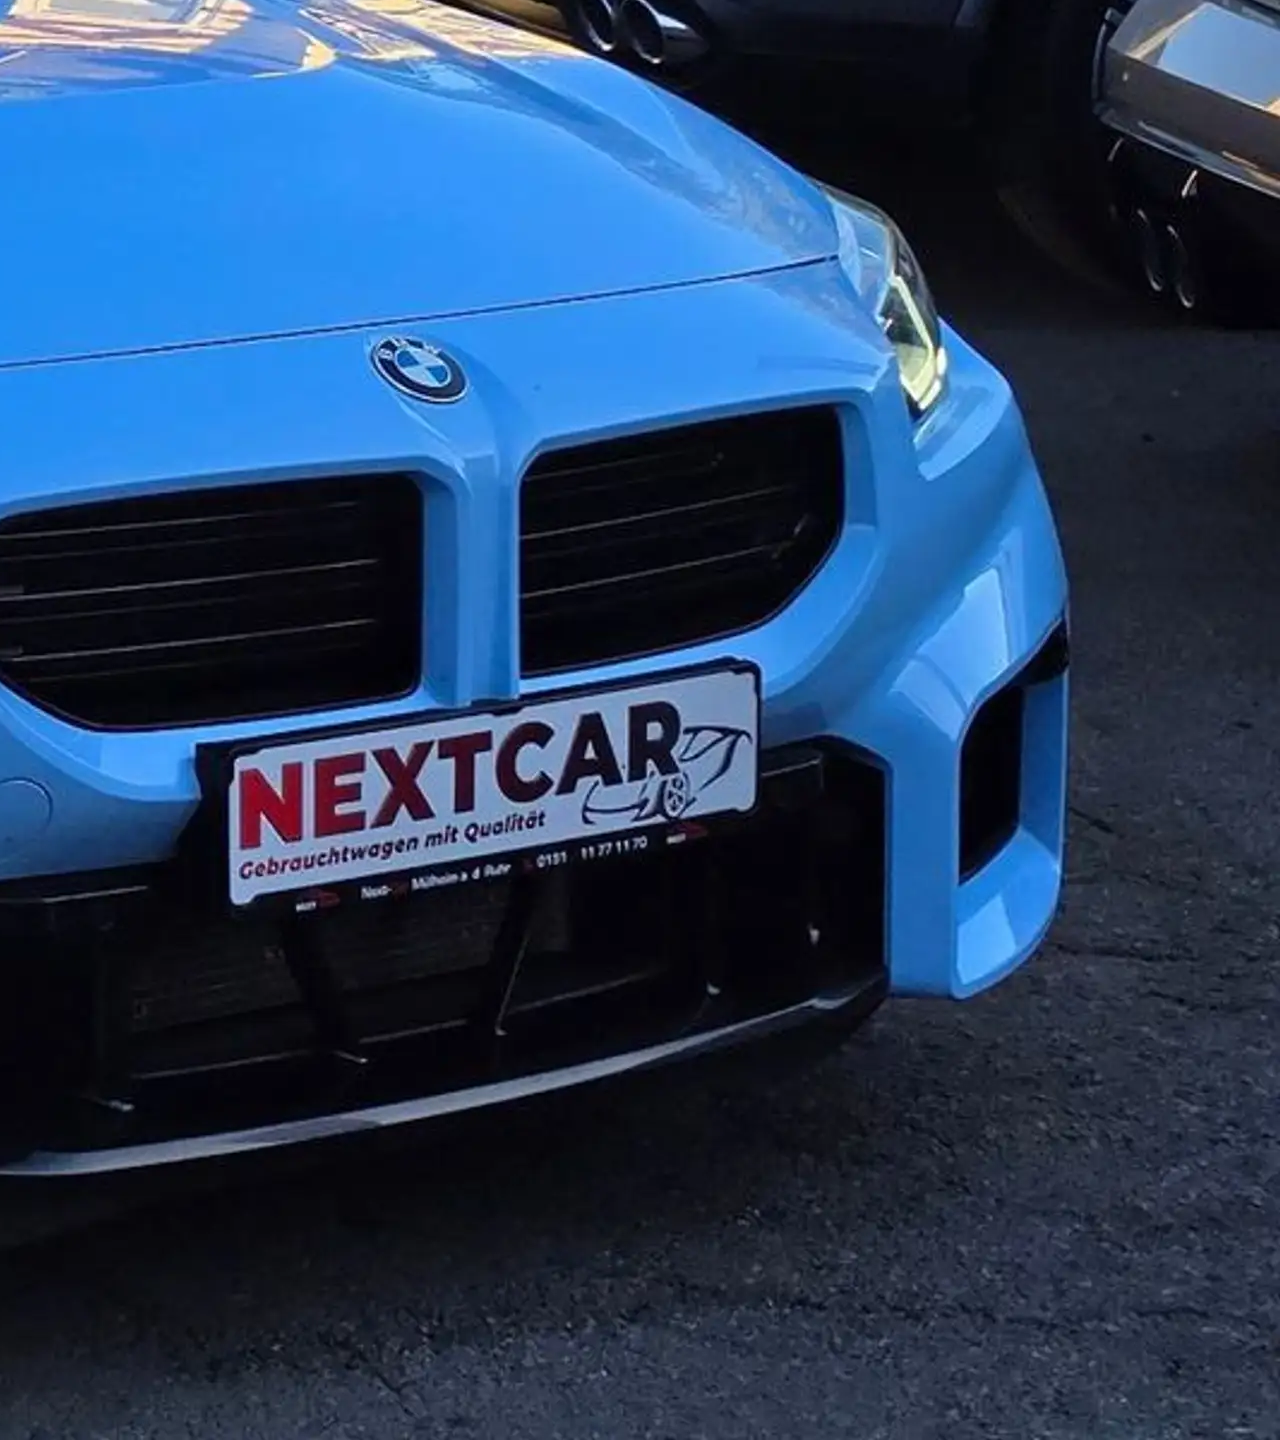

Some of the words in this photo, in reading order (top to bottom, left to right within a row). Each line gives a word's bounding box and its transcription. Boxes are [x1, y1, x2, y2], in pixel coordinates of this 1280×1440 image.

[239, 700, 681, 850] NEXTCAR
[240, 835, 419, 879] Gebrauchtwagen
[423, 823, 459, 848] mit
[464, 810, 546, 845] Qualität
